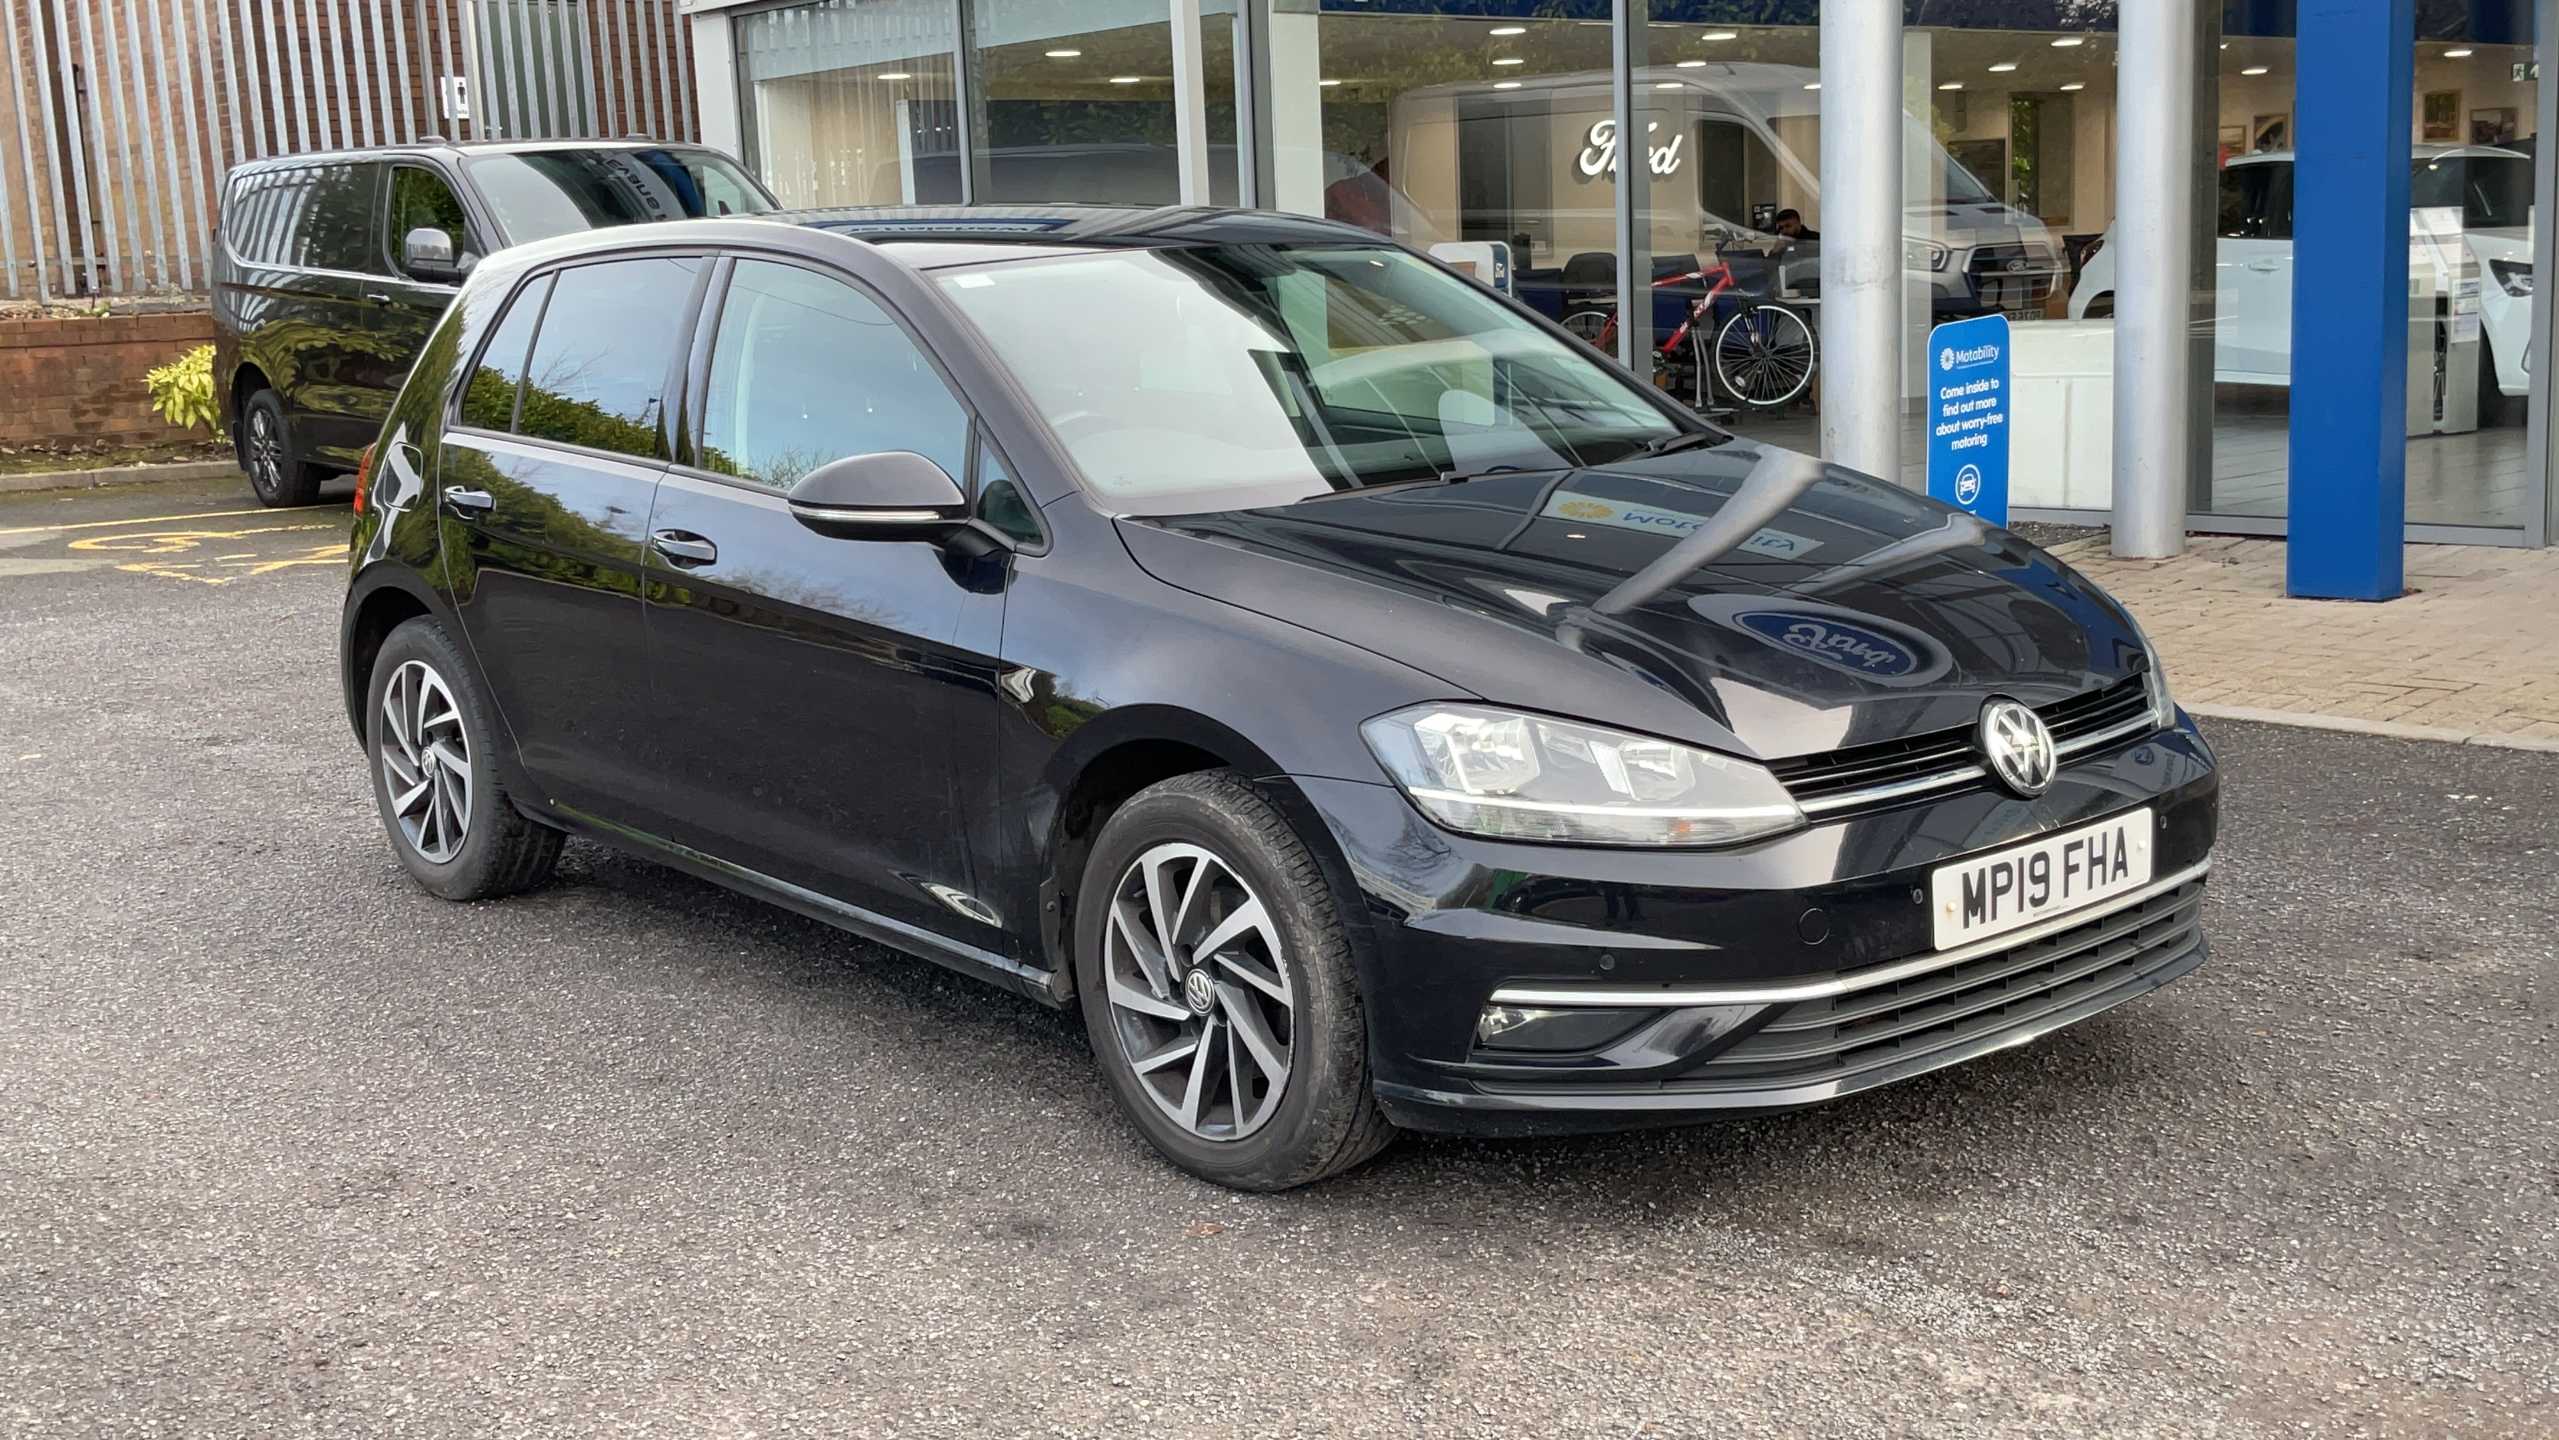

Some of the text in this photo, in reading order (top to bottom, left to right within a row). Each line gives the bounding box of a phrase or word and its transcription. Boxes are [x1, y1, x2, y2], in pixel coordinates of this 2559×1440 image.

[1580, 119, 1683, 176] Fd
[1956, 344, 1999, 363] Motability
[1940, 377, 2000, 400] Come inside to
[1942, 397, 1997, 418] find out more
[1935, 412, 2004, 437] about worry-free
[1951, 433, 1988, 451] motoring
[1961, 826, 2129, 930] MP19 FHA
